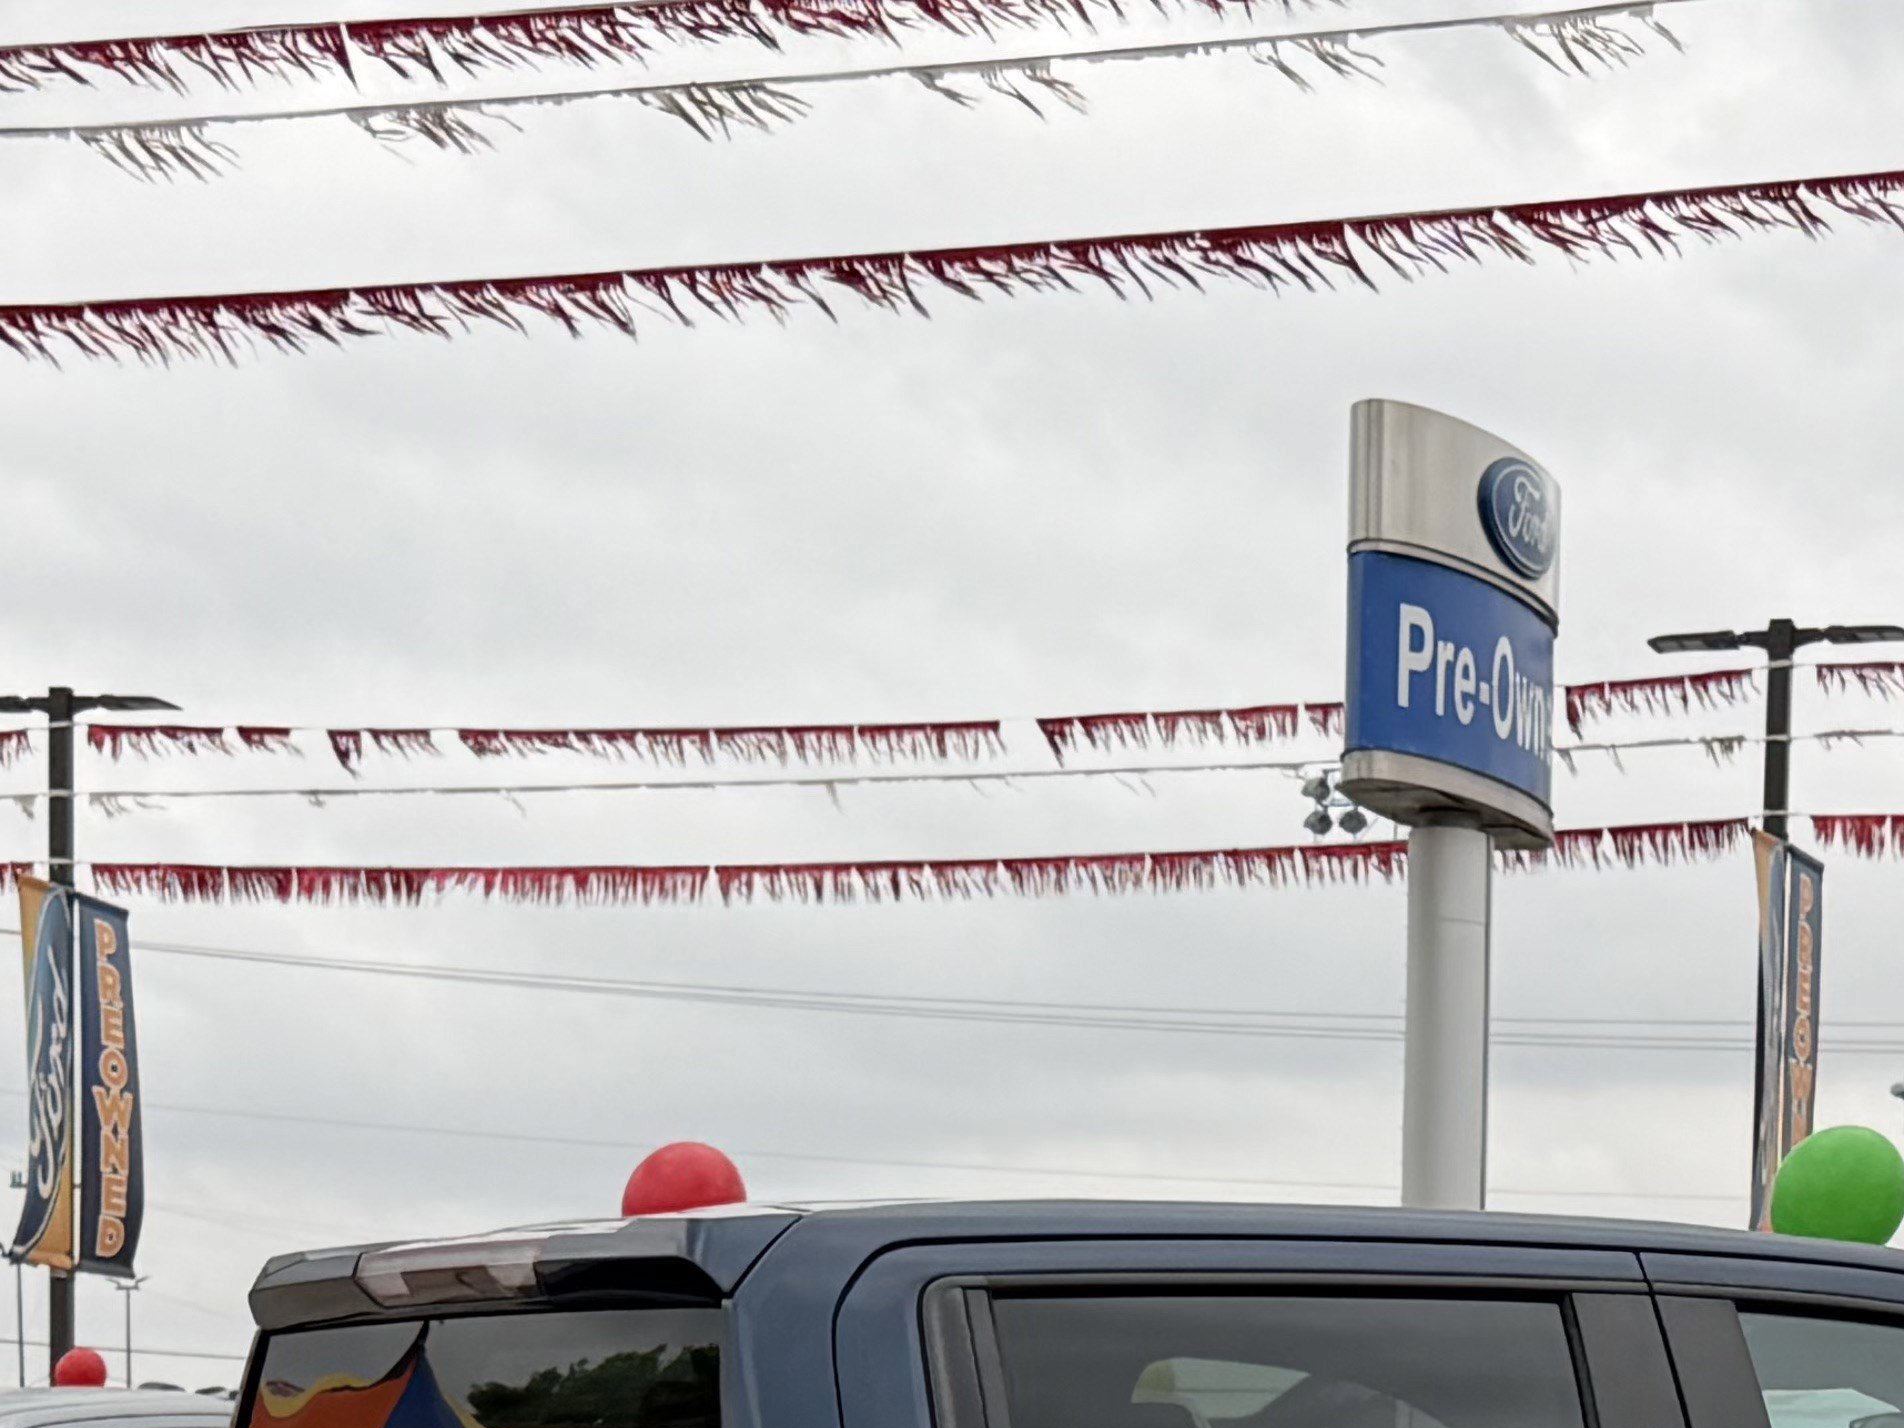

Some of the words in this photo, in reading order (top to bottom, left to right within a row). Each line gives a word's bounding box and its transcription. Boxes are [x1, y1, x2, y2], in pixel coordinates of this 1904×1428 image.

[1398, 603, 1552, 767] Pre-Own
[30, 944, 68, 1200] Ford
[92, 917, 133, 1258] PREOWNED
